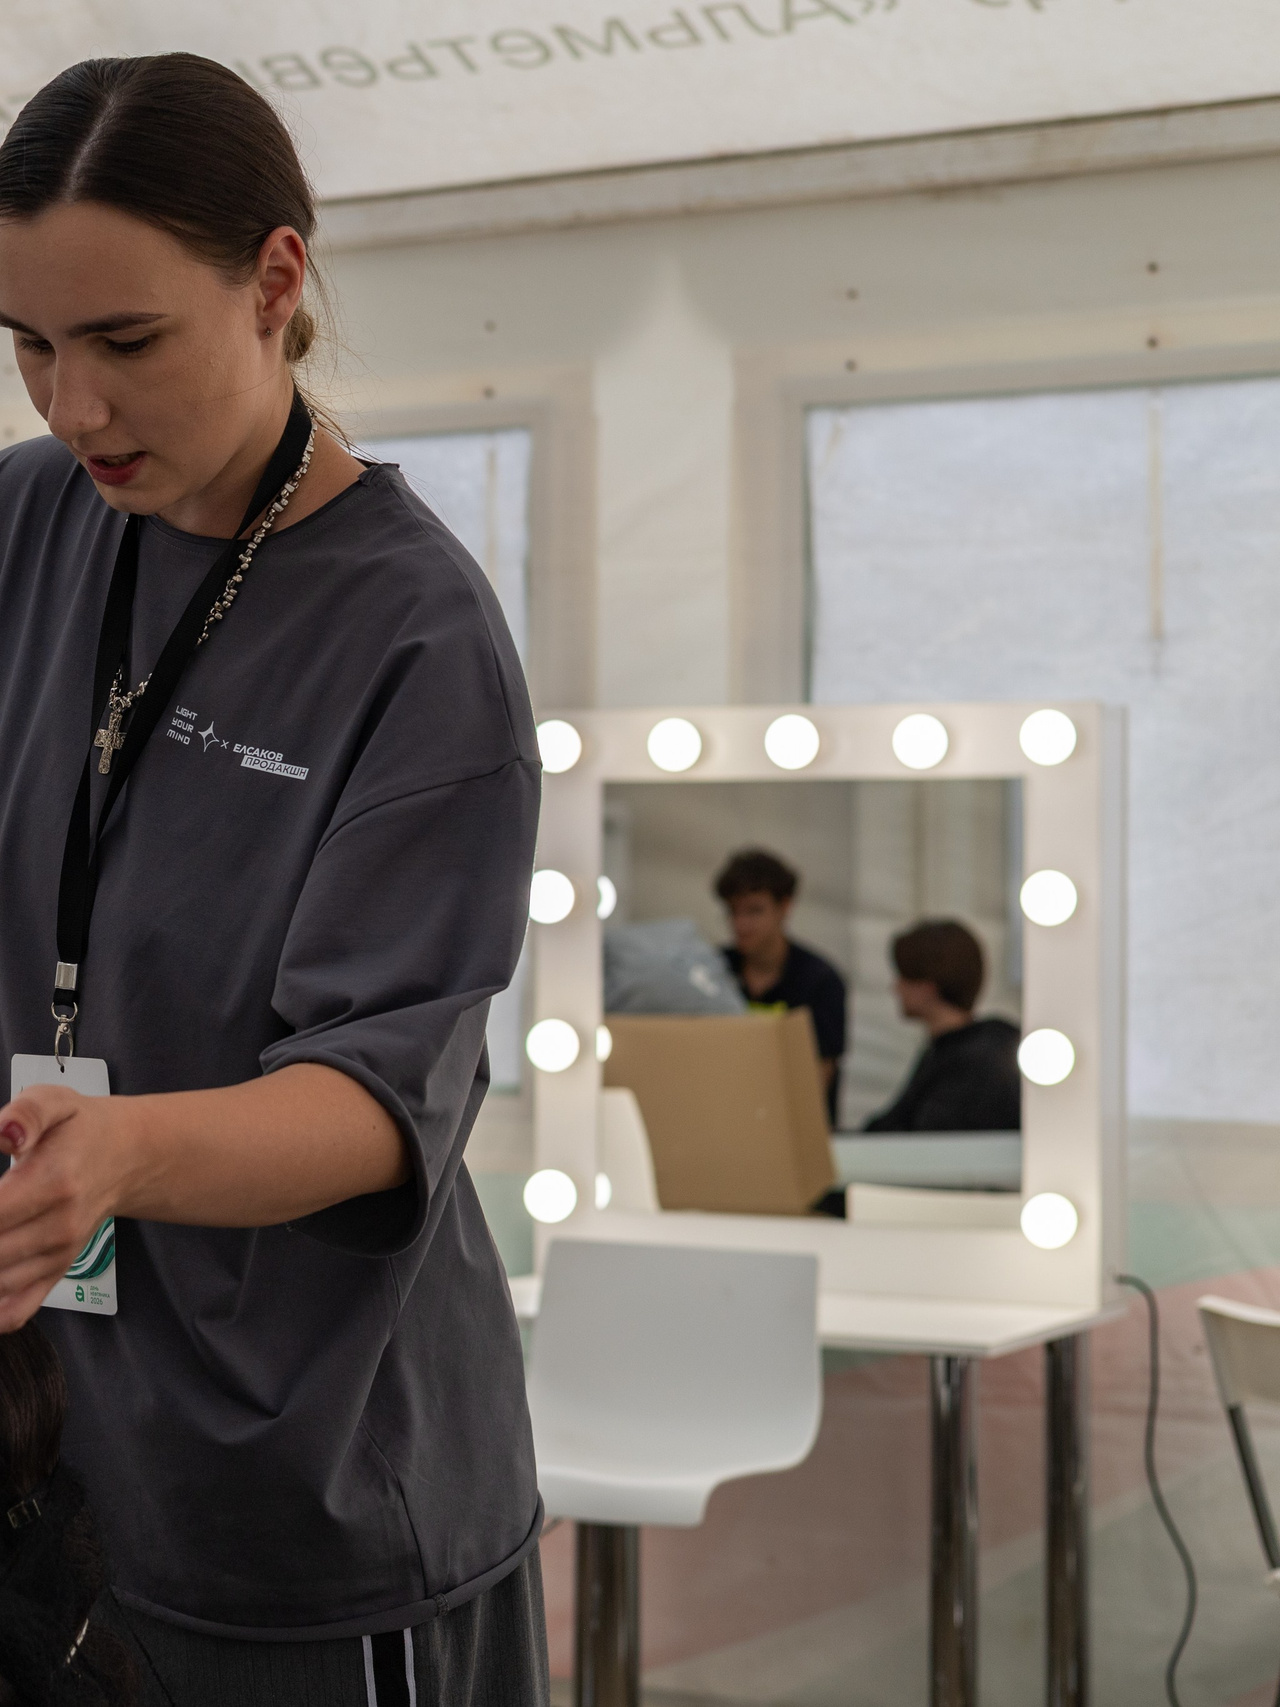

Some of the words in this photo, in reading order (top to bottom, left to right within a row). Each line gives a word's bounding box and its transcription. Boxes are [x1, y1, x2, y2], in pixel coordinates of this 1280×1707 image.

[175, 705, 198, 720] LIGHT
[171, 717, 194, 733] YOUR
[166, 729, 190, 745] MIND
[232, 743, 284, 762] ЕЛСАКОВ
[243, 756, 308, 777] ПРОДАКШН
